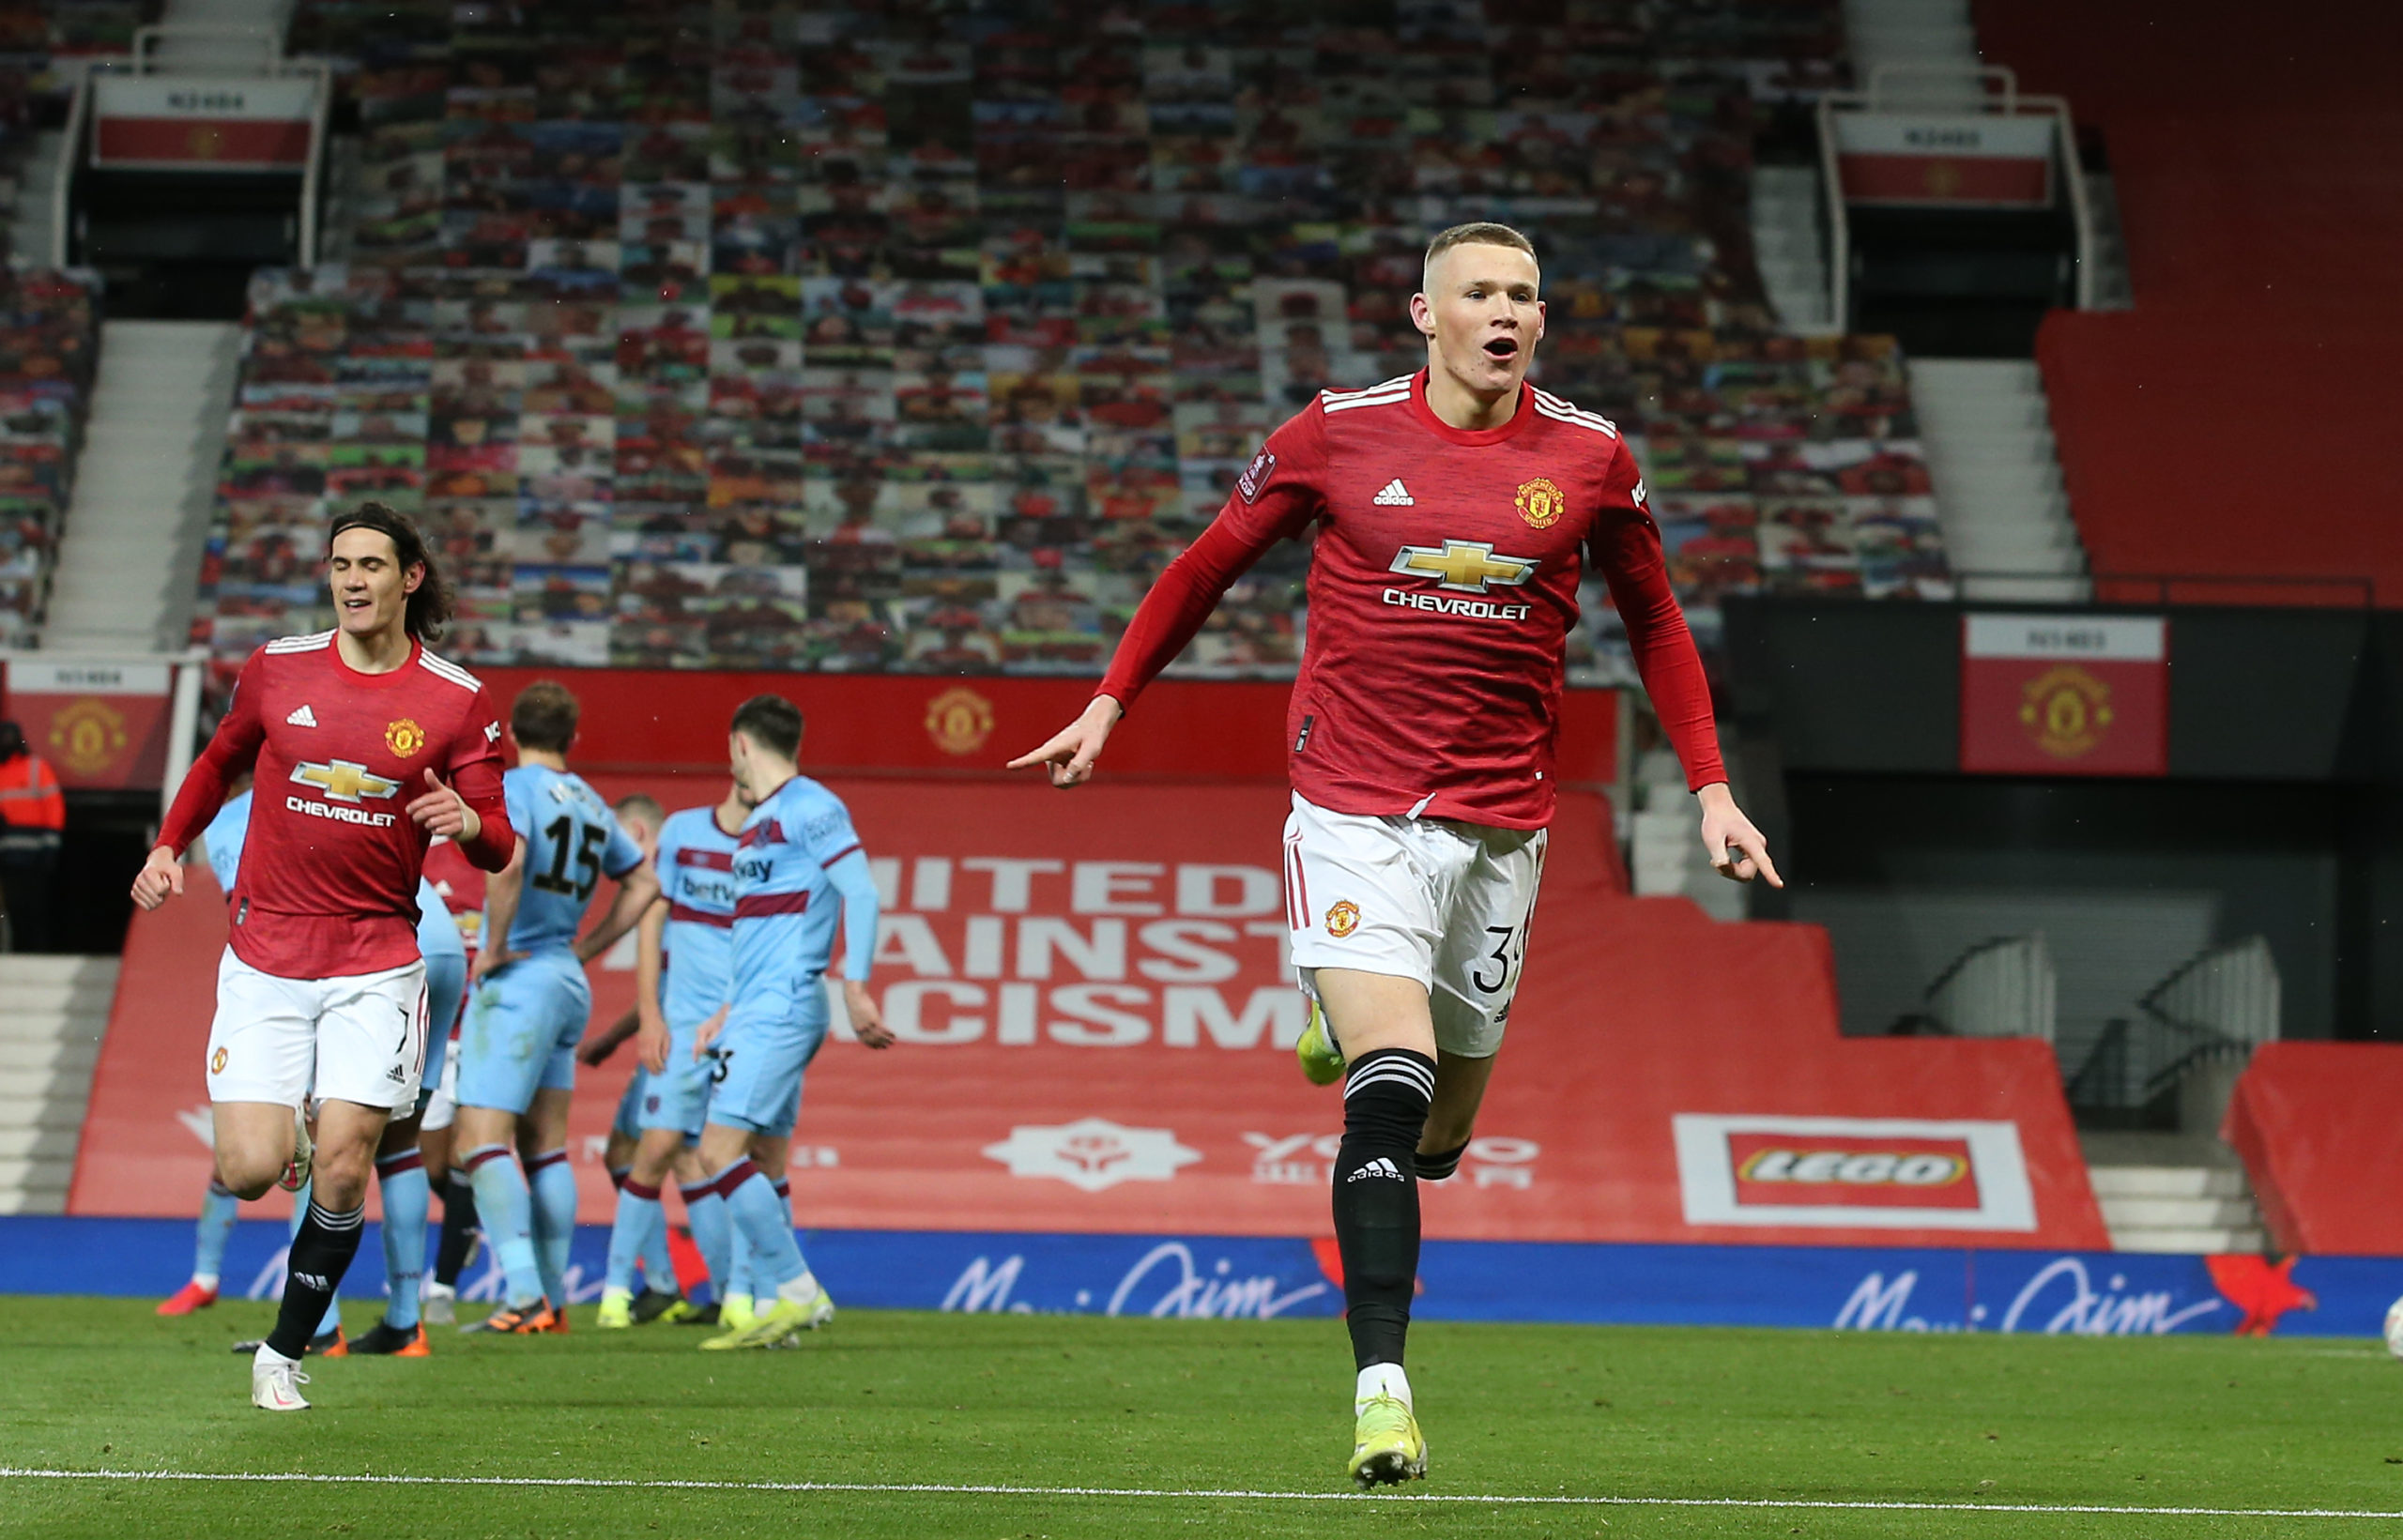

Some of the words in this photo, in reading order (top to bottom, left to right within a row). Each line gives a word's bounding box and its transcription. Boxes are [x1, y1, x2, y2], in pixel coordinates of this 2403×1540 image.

[1372, 496, 1416, 507] adidas
[1382, 587, 1532, 620] CHEVROLET
[285, 795, 397, 828] CHEVROLET
[532, 815, 607, 904] 15
[1347, 1168, 1405, 1183] adidas
[1748, 1151, 1957, 1182] LEGO
